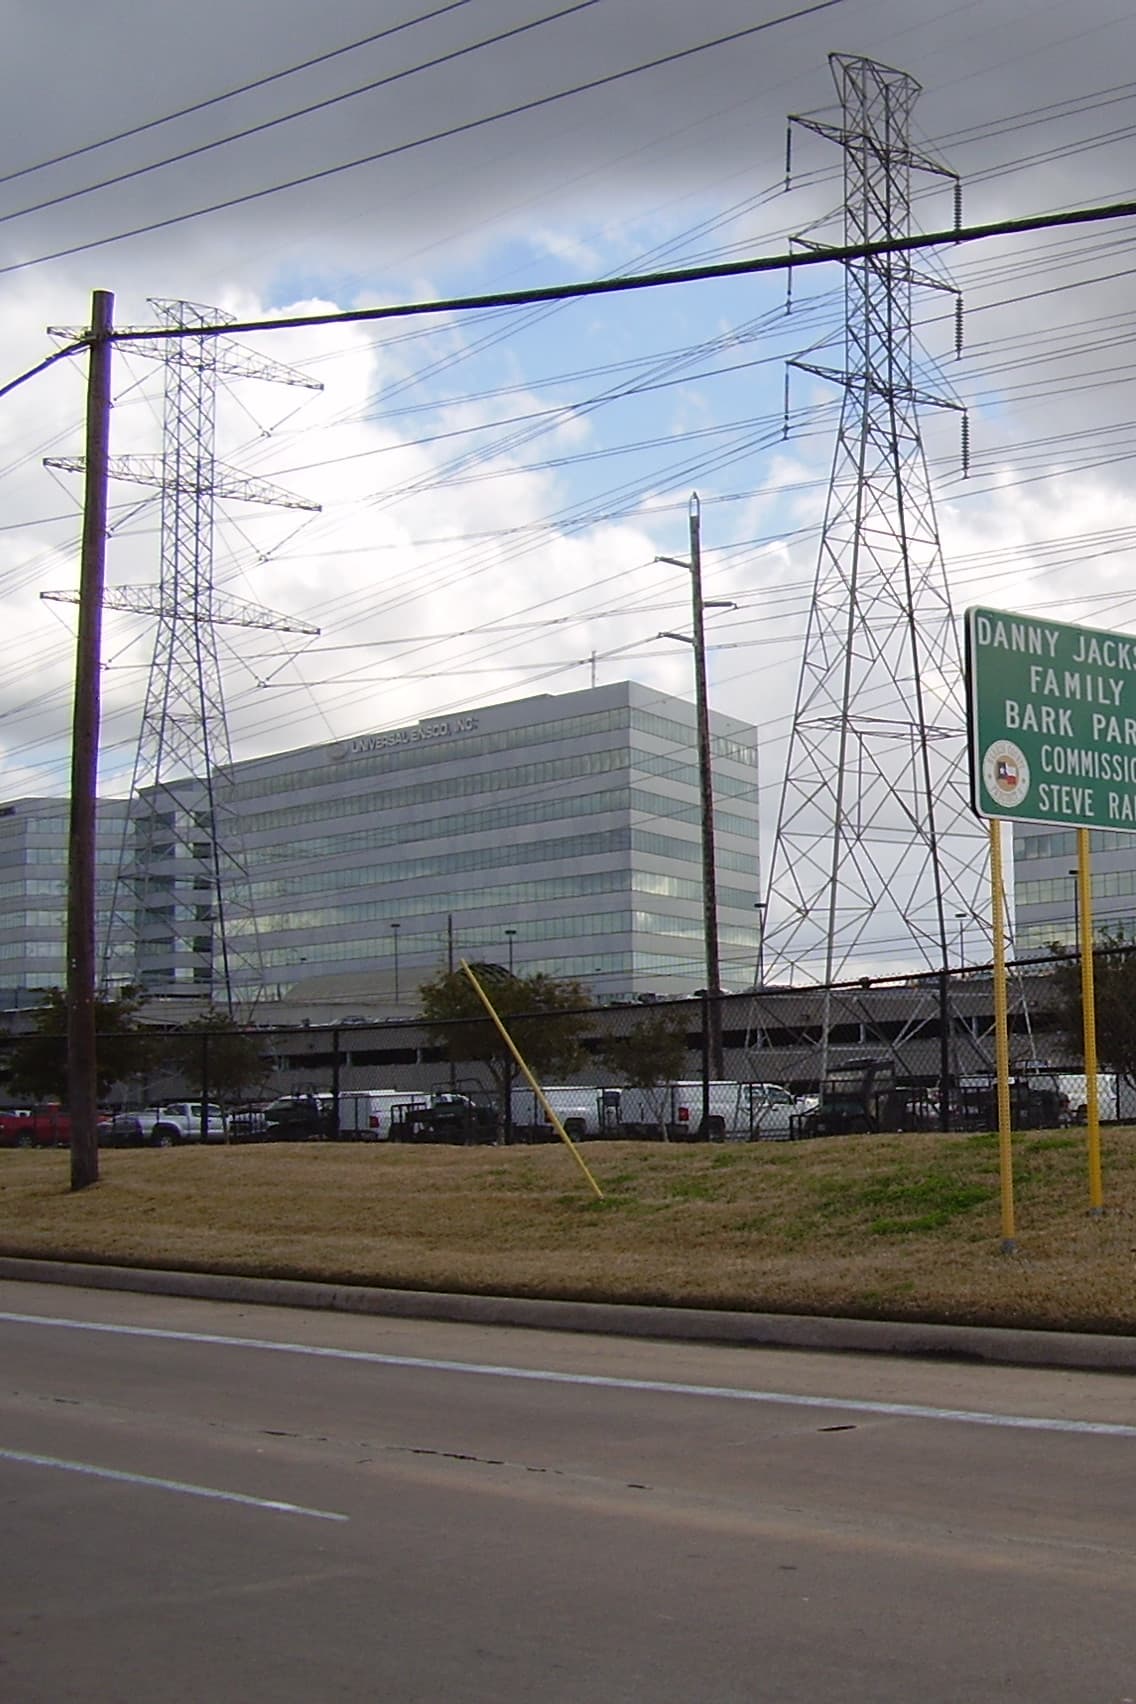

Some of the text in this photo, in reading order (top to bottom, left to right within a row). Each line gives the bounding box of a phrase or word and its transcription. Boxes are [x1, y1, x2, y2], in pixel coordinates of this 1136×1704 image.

[977, 617, 1059, 657] DANNY
[1030, 665, 1125, 706] FAMILY
[1005, 699, 1074, 737] BARK
[1038, 783, 1095, 817] STEVE
